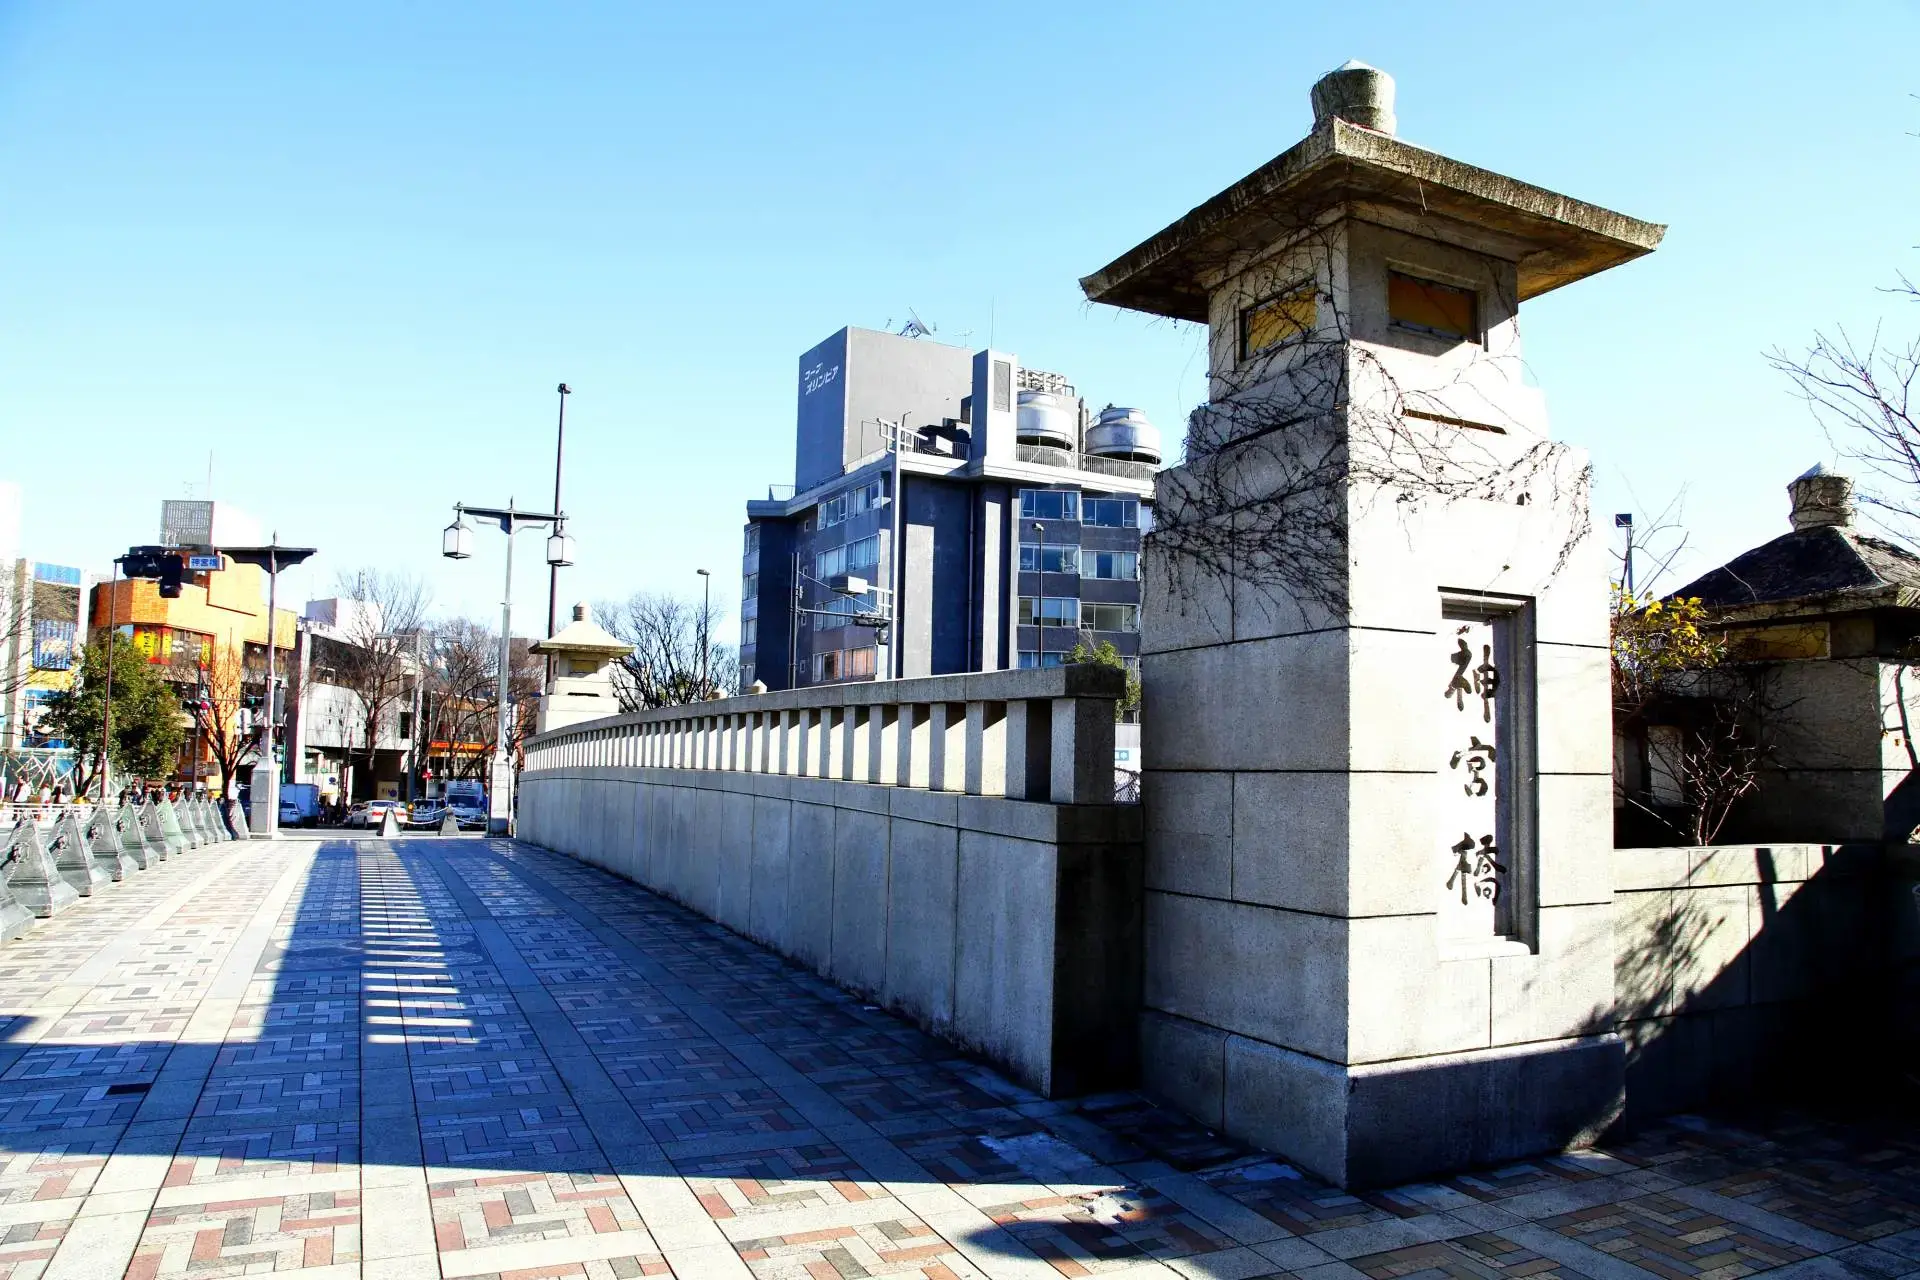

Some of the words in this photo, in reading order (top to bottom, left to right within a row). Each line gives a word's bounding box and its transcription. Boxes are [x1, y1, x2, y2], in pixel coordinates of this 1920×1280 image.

[191, 558, 218, 567] 神宮橋
[1444, 638, 1507, 907] 神宮橋
